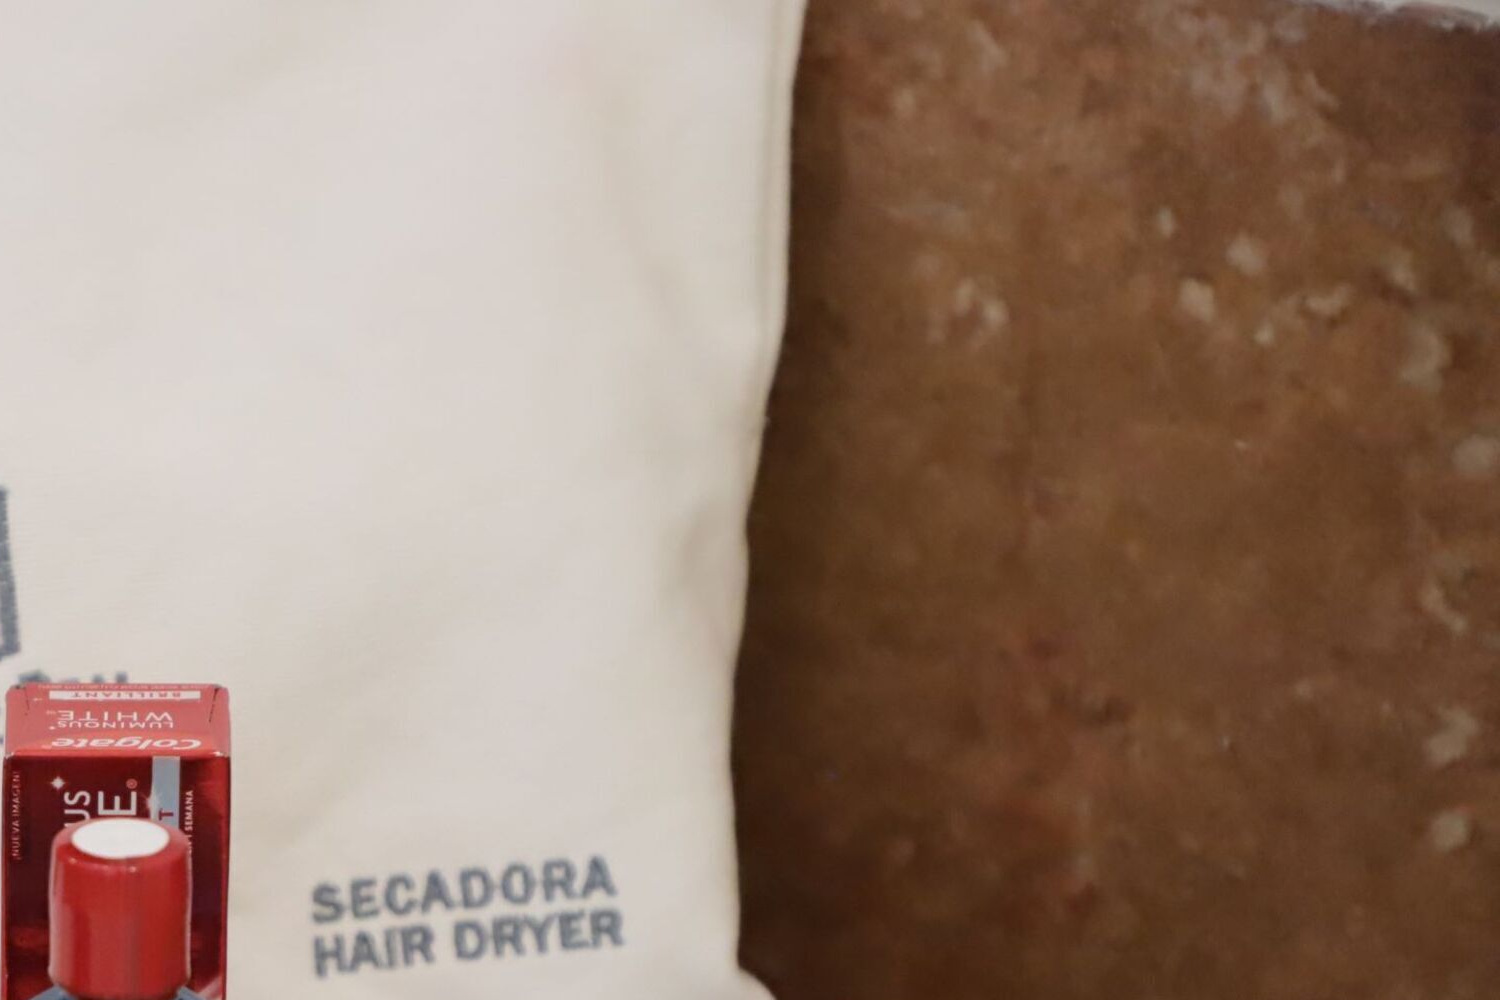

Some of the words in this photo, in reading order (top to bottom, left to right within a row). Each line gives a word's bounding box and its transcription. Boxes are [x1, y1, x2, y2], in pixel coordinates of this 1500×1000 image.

[71, 691, 181, 700] BRILLIANT
[57, 710, 173, 722] WHITE
[56, 720, 175, 730] LUMINOUS
[51, 736, 202, 751] Colgate
[184, 790, 193, 832] SEMANA
[311, 854, 618, 924] SECADORA
[312, 924, 435, 980] HAIR
[453, 908, 625, 961] DRYER
